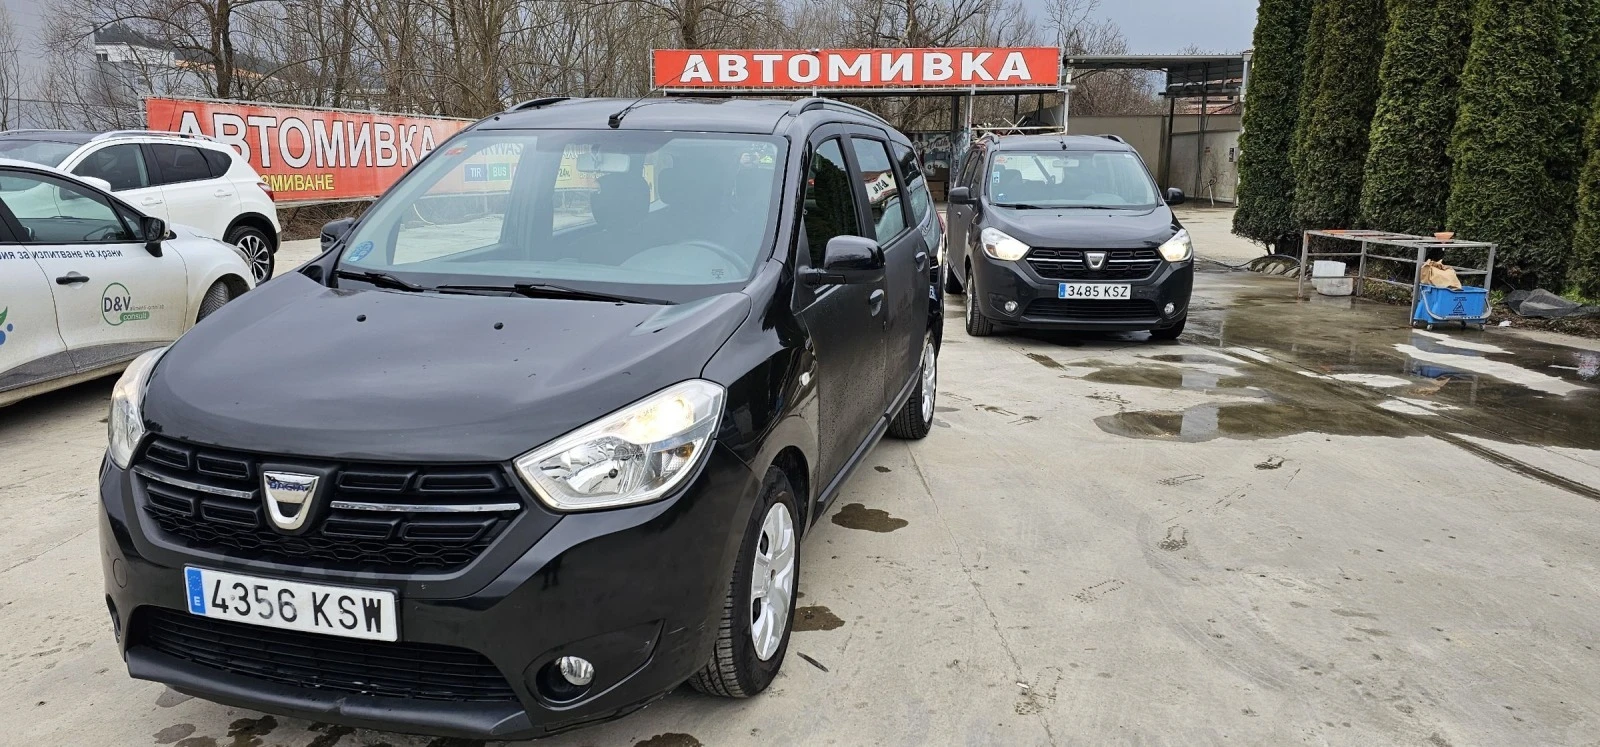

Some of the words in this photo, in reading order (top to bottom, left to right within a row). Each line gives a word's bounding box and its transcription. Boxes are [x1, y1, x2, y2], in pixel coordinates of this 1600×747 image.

[680, 52, 1032, 83] АВТОМИВКА
[470, 167, 482, 178] TIR
[493, 166, 507, 177] BUS
[17, 251, 30, 260] за
[32, 250, 82, 260] изпитване
[84, 250, 95, 258] на
[98, 249, 123, 260] храни
[1068, 285, 1099, 298] 3485
[1104, 286, 1128, 298] KSZ
[104, 296, 131, 312] D&V
[123, 313, 147, 321] consult
[194, 596, 201, 606] E
[211, 580, 298, 622] 4356
[311, 591, 382, 633] KSW
